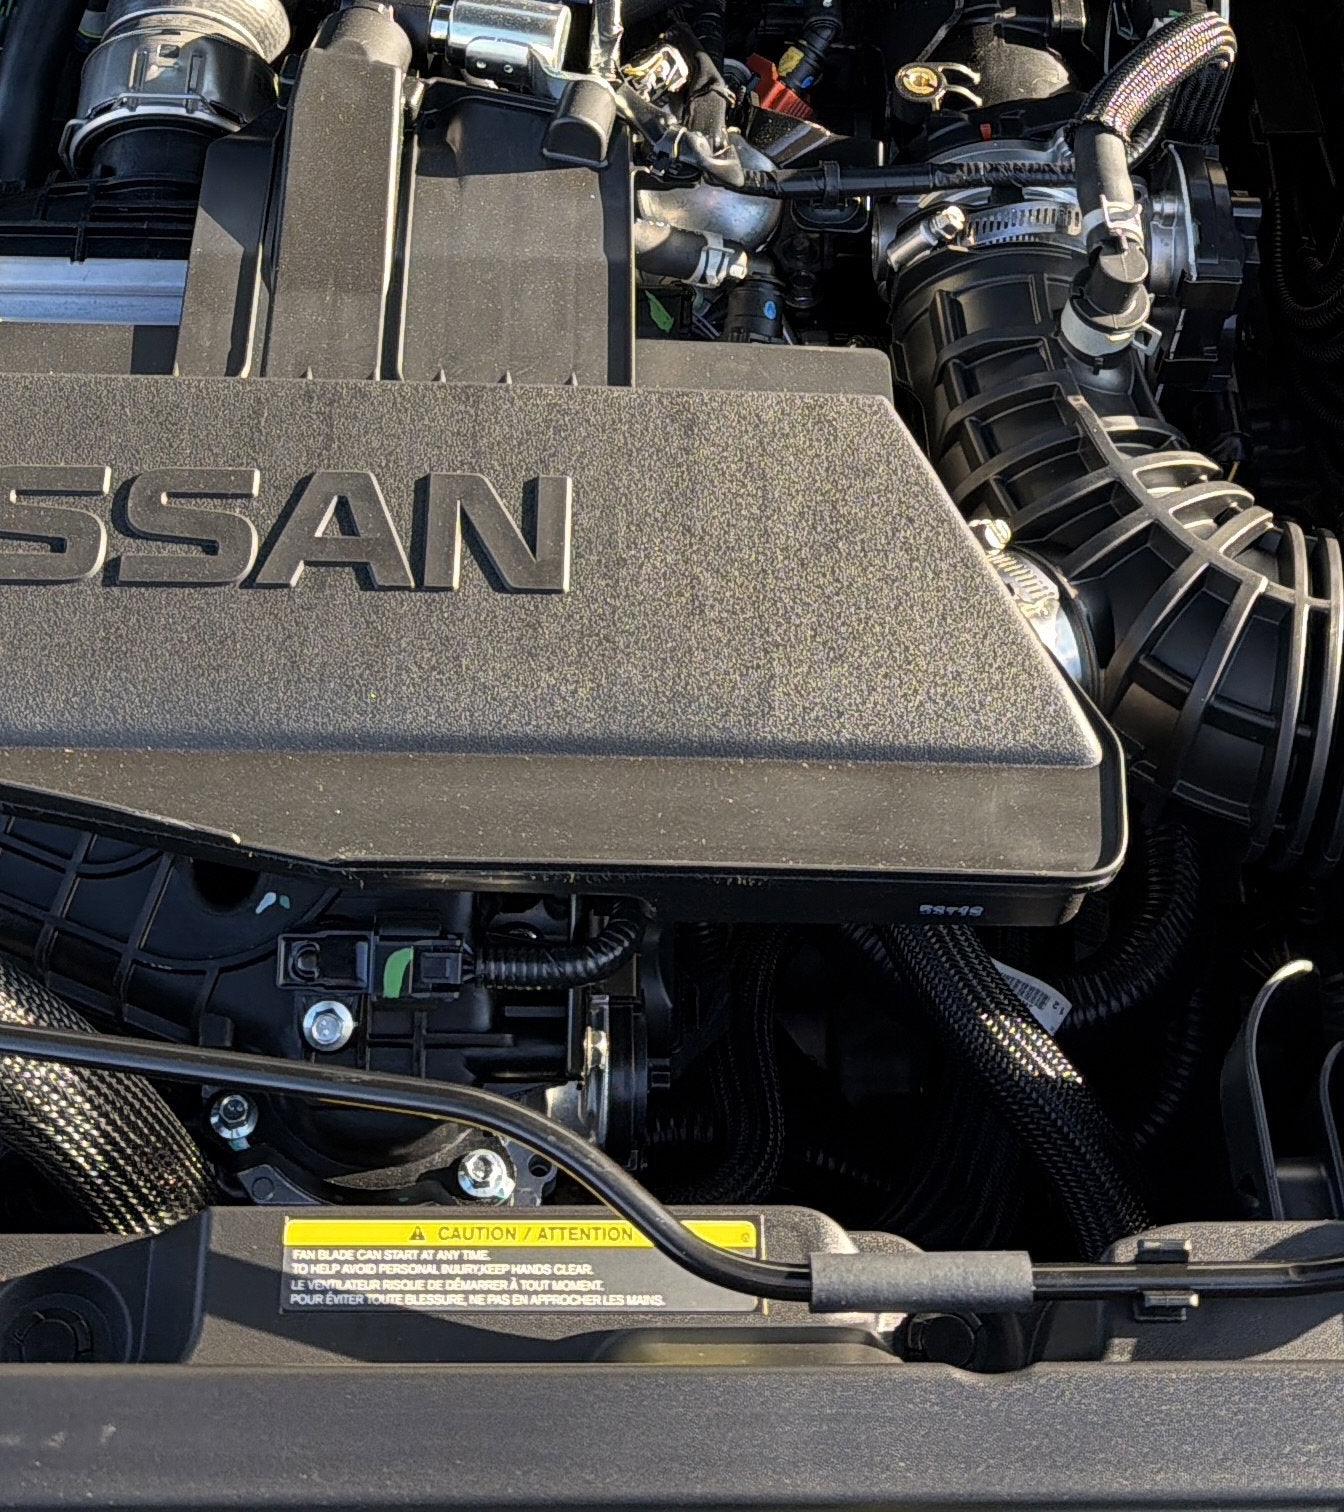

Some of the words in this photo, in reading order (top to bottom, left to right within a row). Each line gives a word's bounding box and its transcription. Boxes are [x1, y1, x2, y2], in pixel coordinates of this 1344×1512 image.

[438, 1226, 517, 1242] CAUTION
[522, 1226, 532, 1242] /
[537, 1226, 634, 1242] ATTENTION
[292, 1249, 315, 1261] FAN
[317, 1249, 355, 1261] BLADE
[357, 1249, 382, 1261] CAN
[383, 1249, 419, 1261] START
[420, 1249, 435, 1261] AT
[436, 1249, 459, 1261] ANY
[462, 1249, 491, 1261] TIME.
[292, 1263, 309, 1276] TO
[310, 1263, 341, 1276] HELP
[341, 1263, 376, 1276] AVOID
[378, 1263, 439, 1276] PERSONAL
[511, 1263, 552, 1276] HANDS
[553, 1263, 594, 1276] CLEAR.
[290, 1279, 305, 1291] LE
[307, 1279, 381, 1291] VENTILATEUR
[382, 1279, 426, 1291] RISQUE
[427, 1279, 444, 1291] DE
[446, 1276, 508, 1291] DÉMARRER
[510, 1276, 519, 1291] À
[519, 1279, 550, 1291] TOUT
[552, 1279, 605, 1291] MOMENT.
[290, 1294, 324, 1306] POUR
[325, 1291, 364, 1306] ÉVITER
[366, 1294, 403, 1306] TOUTE
[406, 1294, 467, 1306] BLESSURE,
[469, 1294, 486, 1306] NE
[487, 1294, 510, 1306] PAS
[512, 1294, 529, 1306] EN
[529, 1294, 601, 1306] APPROCHER
[602, 1294, 624, 1306] LES
[625, 1294, 666, 1306] MAINS.
